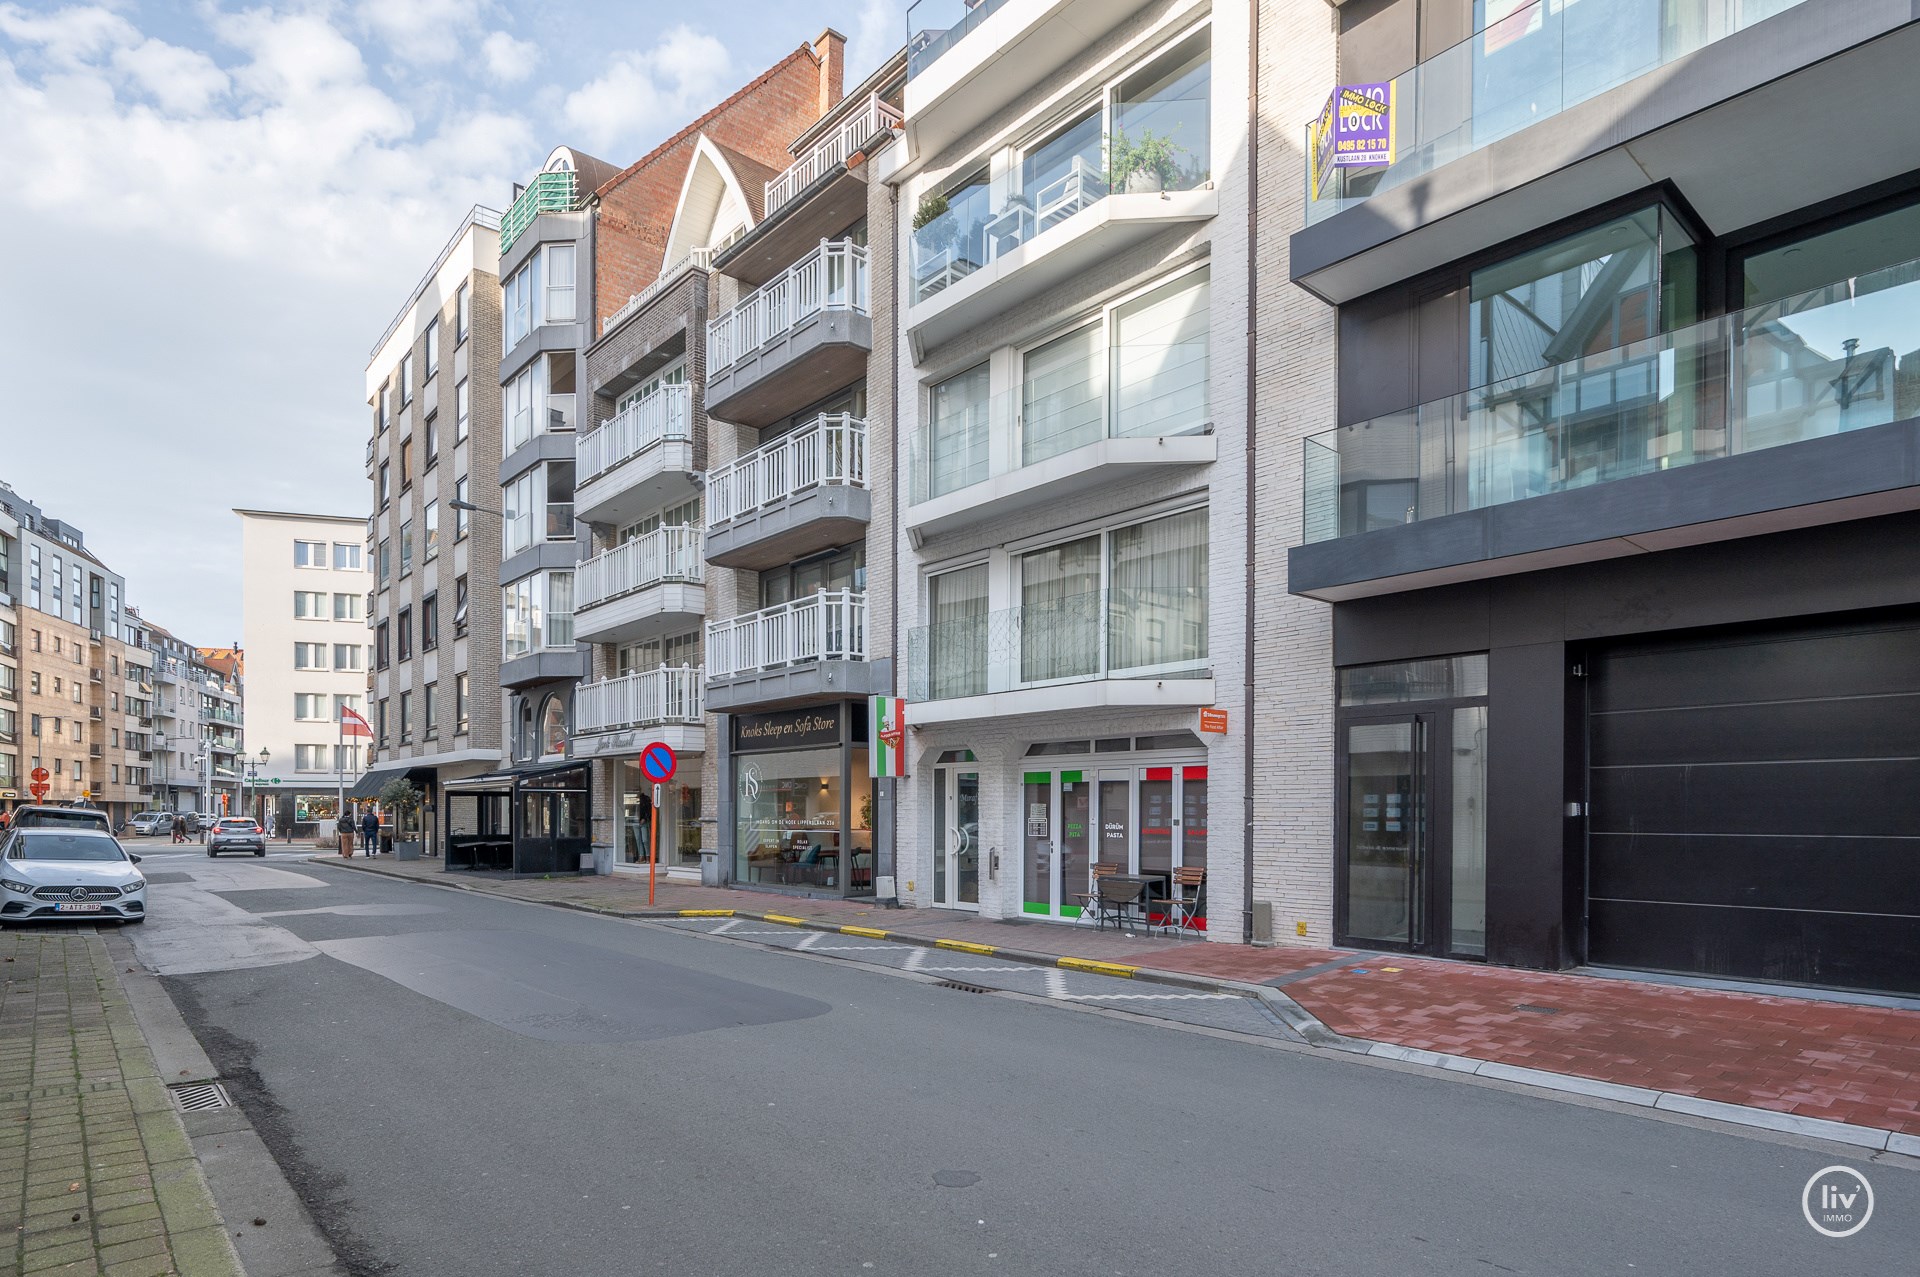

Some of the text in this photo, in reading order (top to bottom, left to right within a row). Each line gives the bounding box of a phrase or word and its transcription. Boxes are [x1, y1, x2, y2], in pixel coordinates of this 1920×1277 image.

[1342, 89, 1365, 104] IMMO
[1364, 99, 1387, 114] LOCK
[1340, 112, 1382, 132] LOCK
[1367, 139, 1376, 150] 15
[1377, 138, 1387, 149] 70
[740, 716, 835, 739] Knoks Sleep en Sofa Store
[1105, 822, 1124, 830] DÜRÜM
